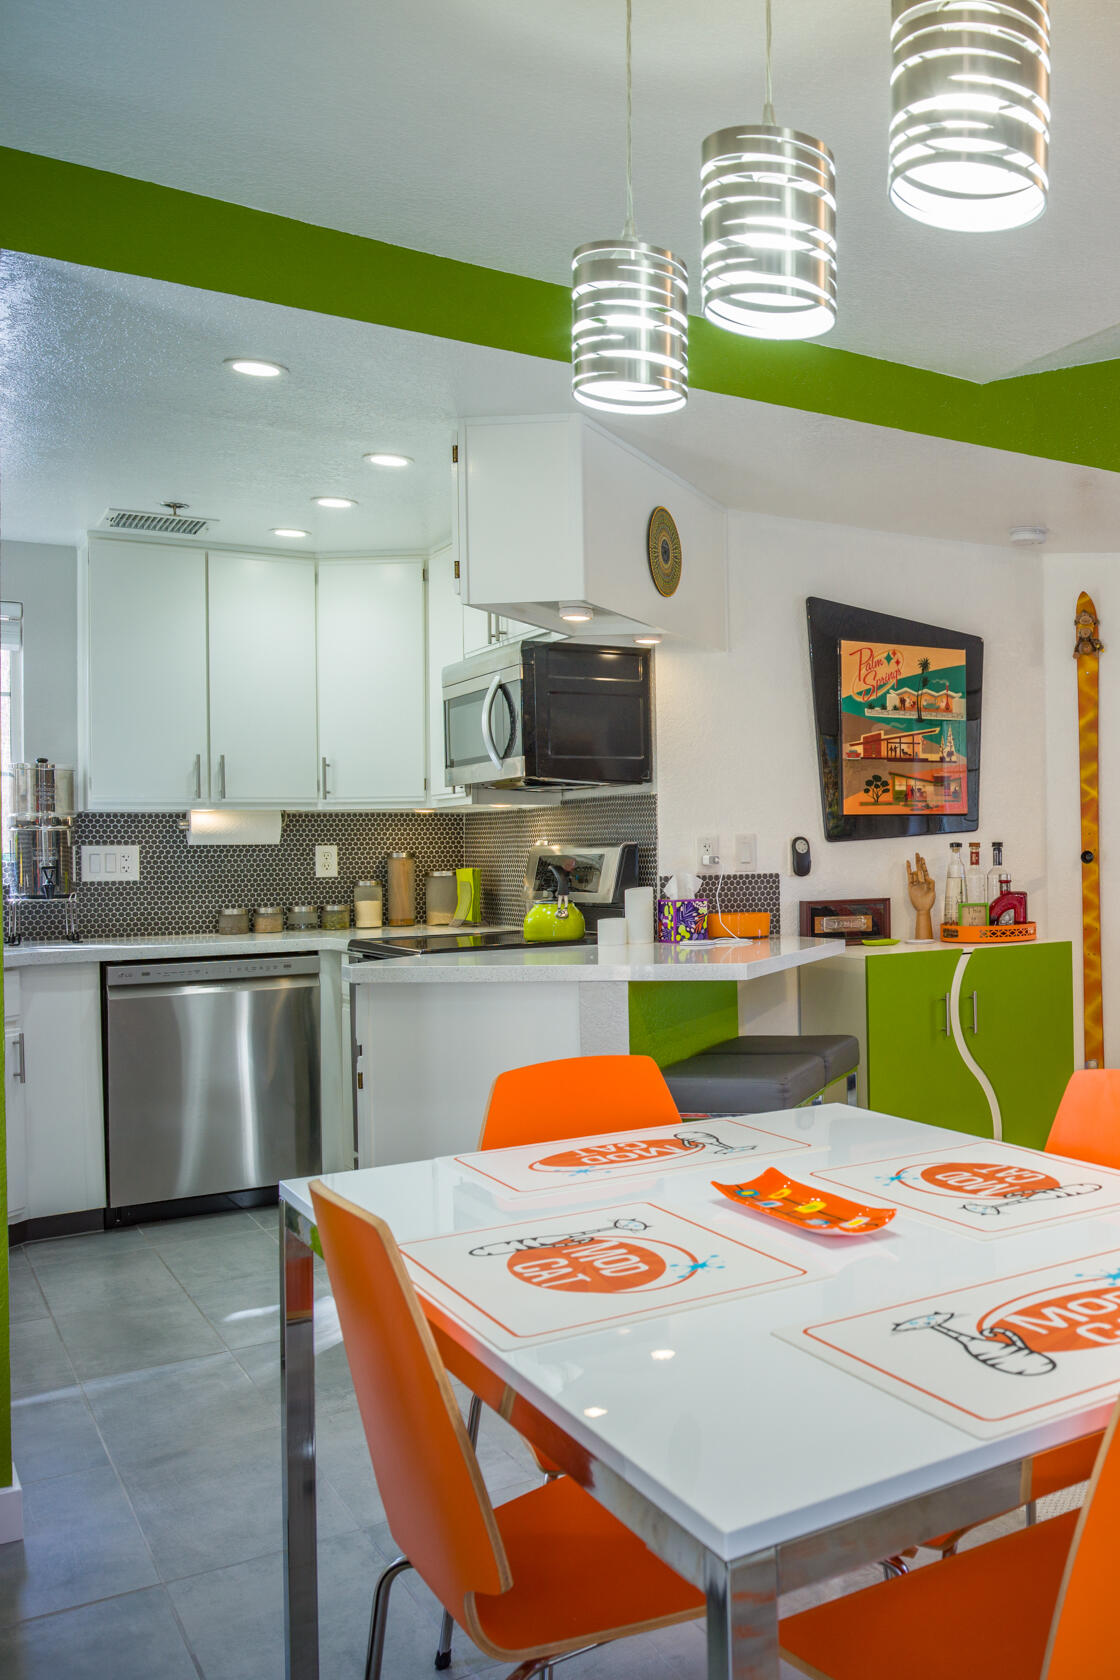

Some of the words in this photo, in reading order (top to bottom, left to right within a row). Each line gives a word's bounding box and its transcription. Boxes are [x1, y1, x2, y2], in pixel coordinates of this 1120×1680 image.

[849, 647, 883, 682] Palm
[862, 668, 902, 703] Springs
[576, 1141, 649, 1158] CAT
[580, 1144, 681, 1163] MOD
[934, 1171, 1021, 1197] MOD
[973, 1165, 1046, 1183] CAT
[512, 1257, 592, 1288] CAT
[562, 1240, 649, 1277] MOD
